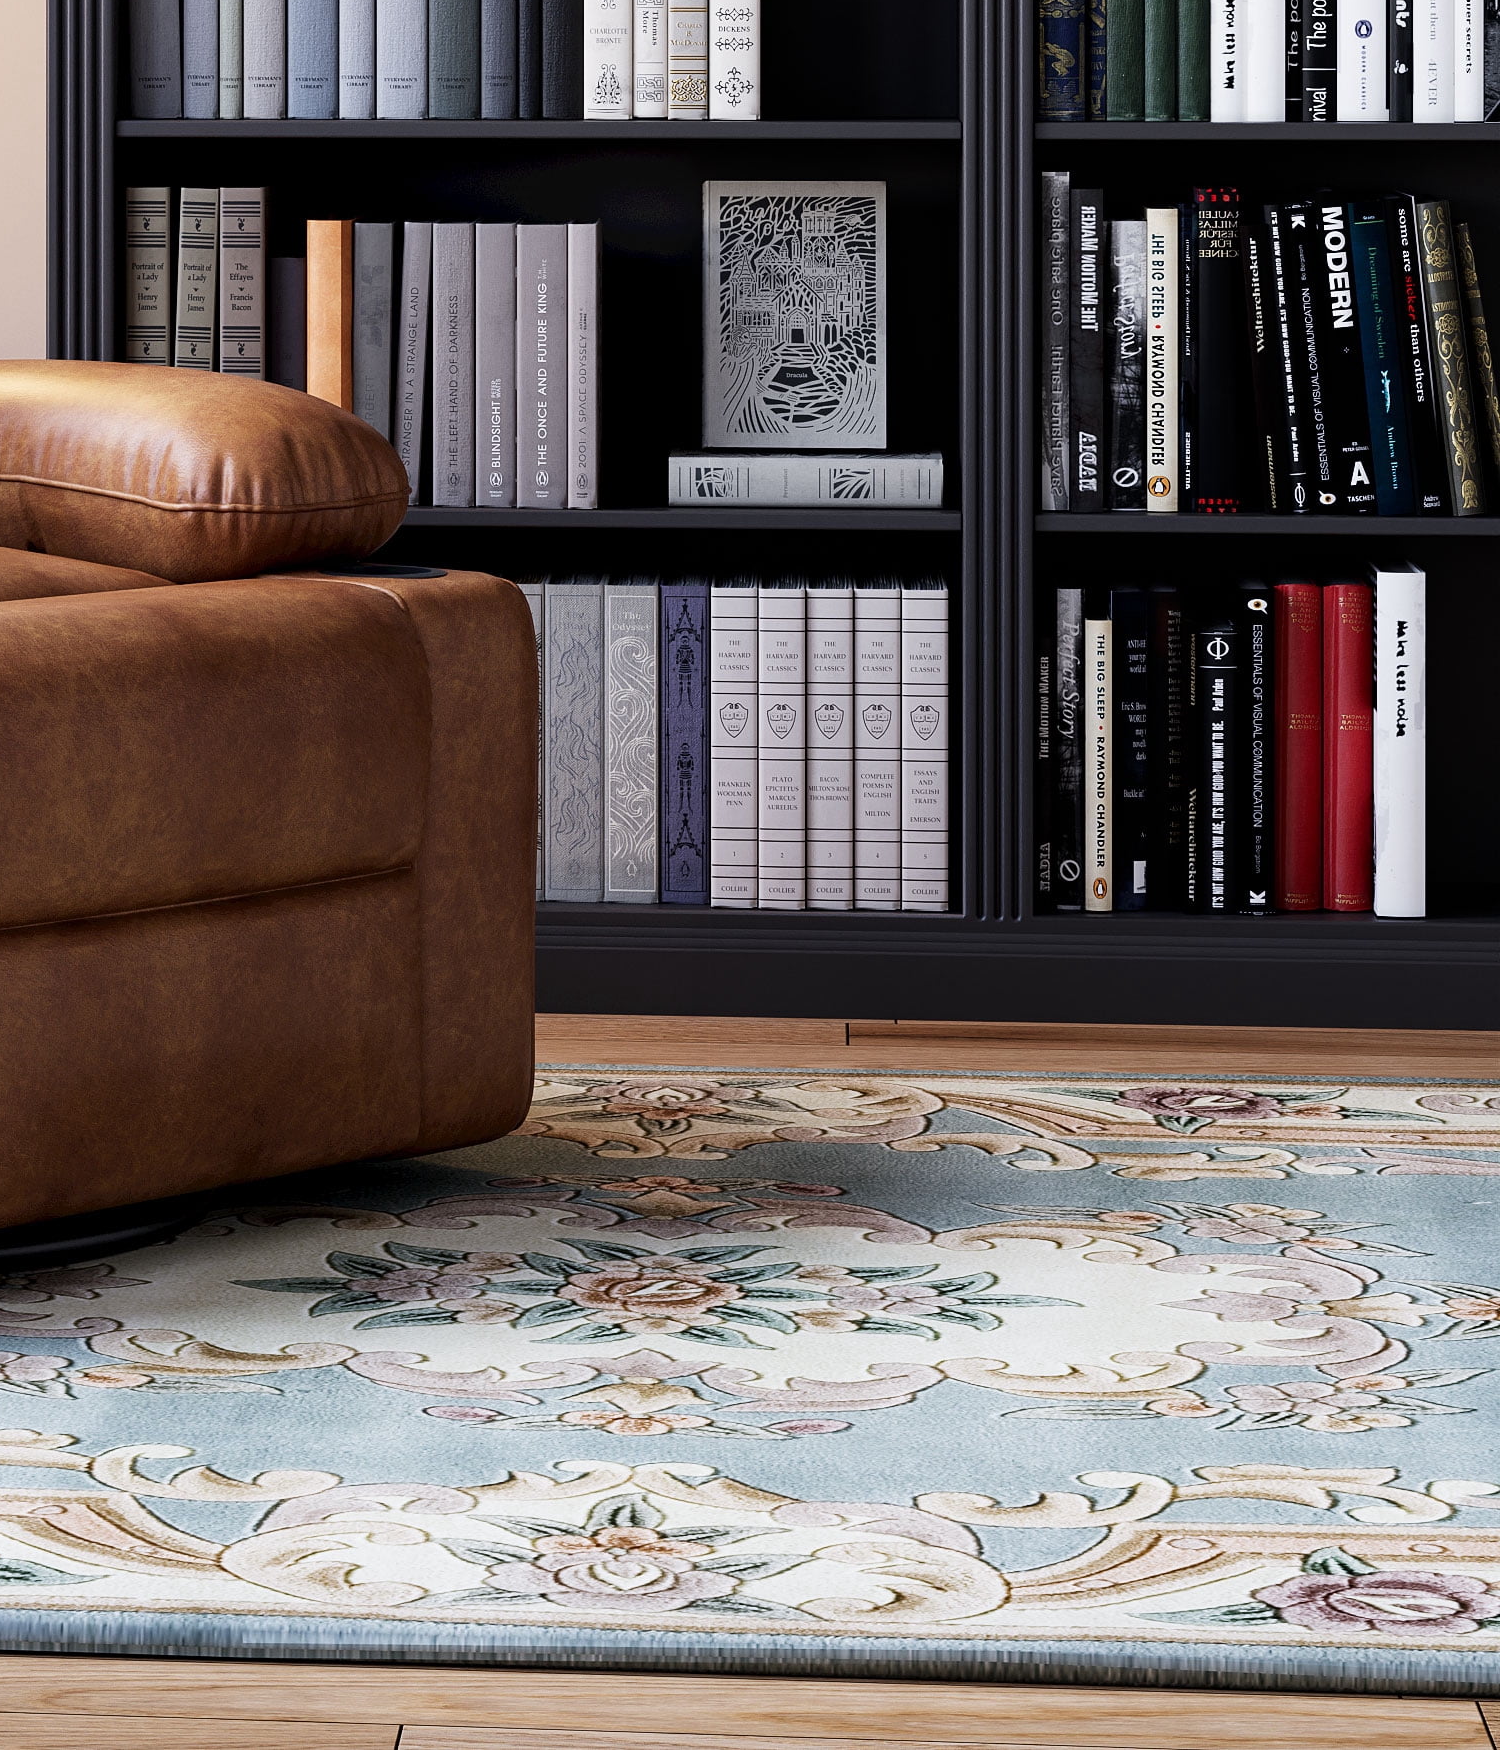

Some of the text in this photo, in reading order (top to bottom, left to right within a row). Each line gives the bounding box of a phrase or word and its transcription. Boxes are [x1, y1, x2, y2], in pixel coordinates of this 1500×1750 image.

[1307, 22, 1326, 50] The
[143, 273, 158, 281] Lady
[1321, 207, 1354, 329] MODERN
[1398, 209, 1425, 402] some are sicker than others
[538, 283, 547, 466] THE ONCE AND FUTURE KING
[579, 390, 587, 422] SPACE
[492, 401, 500, 467] BLINDSIGHT
[578, 441, 587, 467] 2001
[1347, 494, 1375, 502] TASCHEN
[1396, 621, 1409, 737] Make less noise
